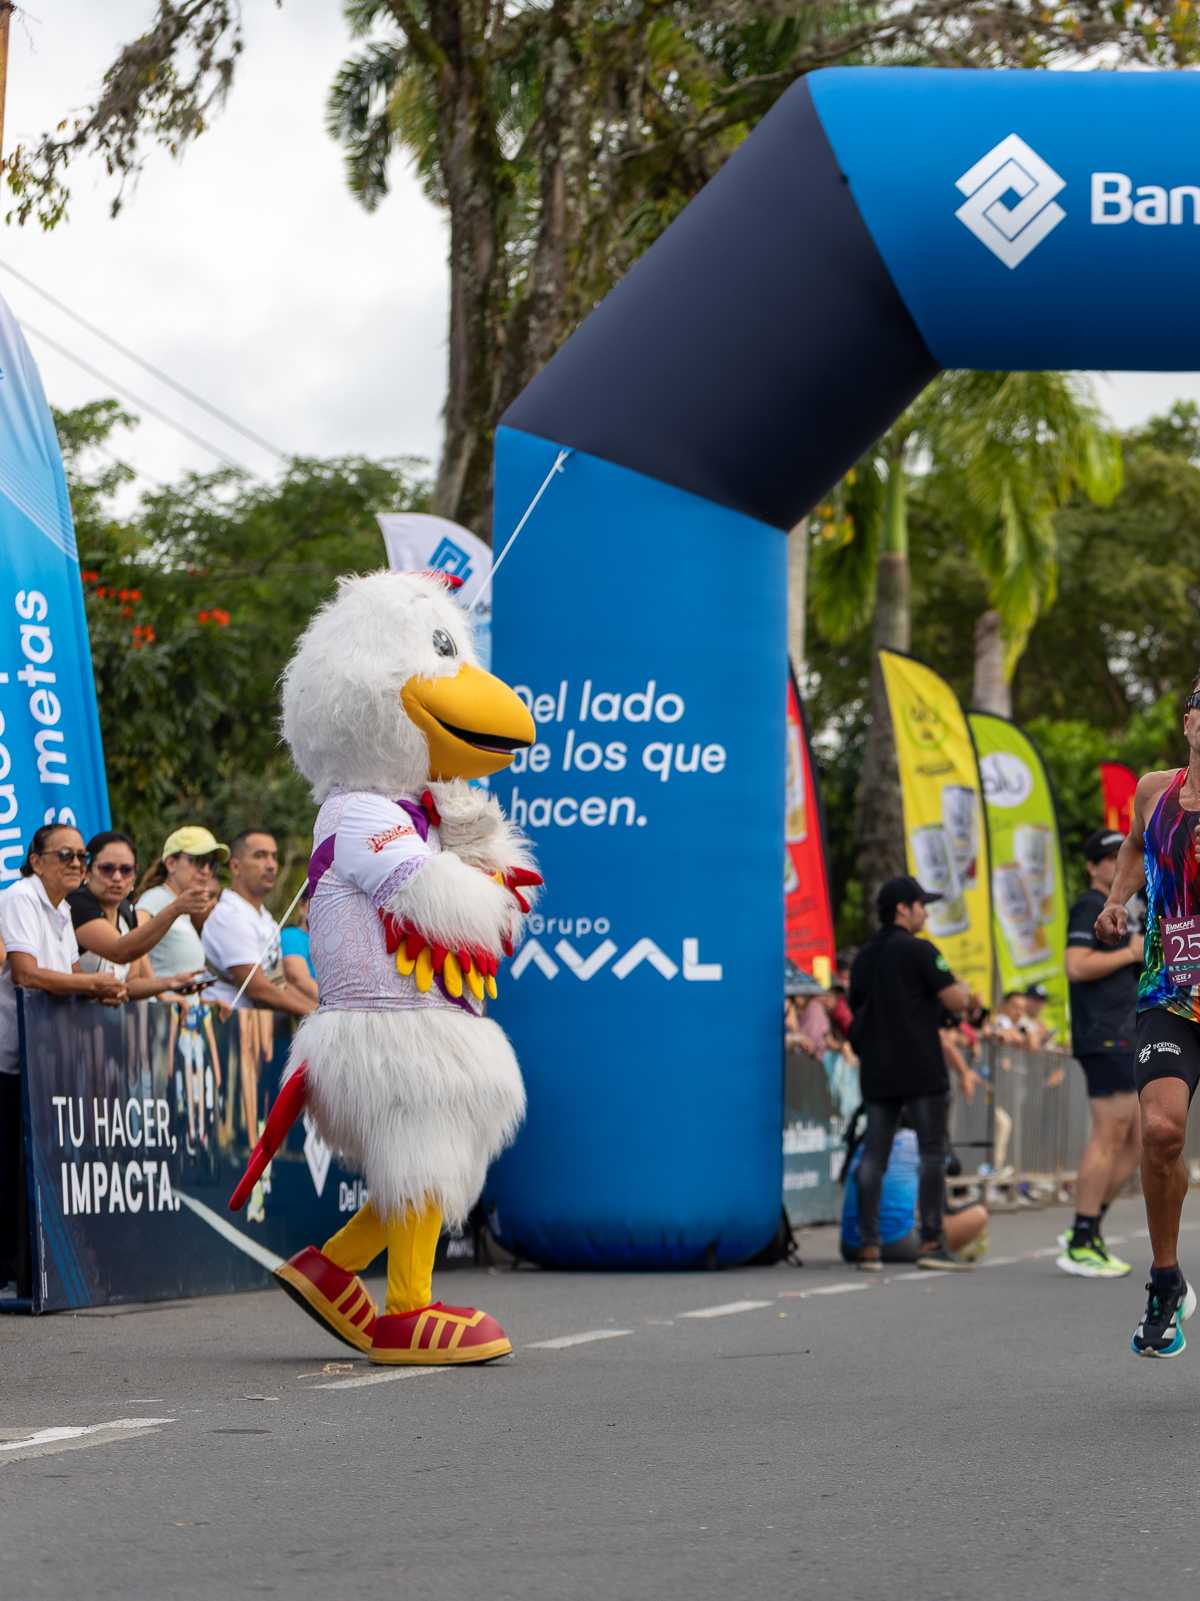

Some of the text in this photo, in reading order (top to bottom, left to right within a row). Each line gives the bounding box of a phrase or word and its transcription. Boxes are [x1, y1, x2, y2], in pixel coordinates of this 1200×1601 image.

[15, 589, 70, 786] metas
[579, 679, 685, 723] lado
[563, 729, 628, 772] los
[642, 741, 727, 783] que
[510, 787, 648, 828] hacen.
[528, 914, 611, 939] Grupo
[510, 938, 722, 981] AVAL
[52, 1096, 177, 1155] TU HACER,
[61, 1160, 180, 1216] IMPACTA.
[339, 1181, 357, 1212] Del
